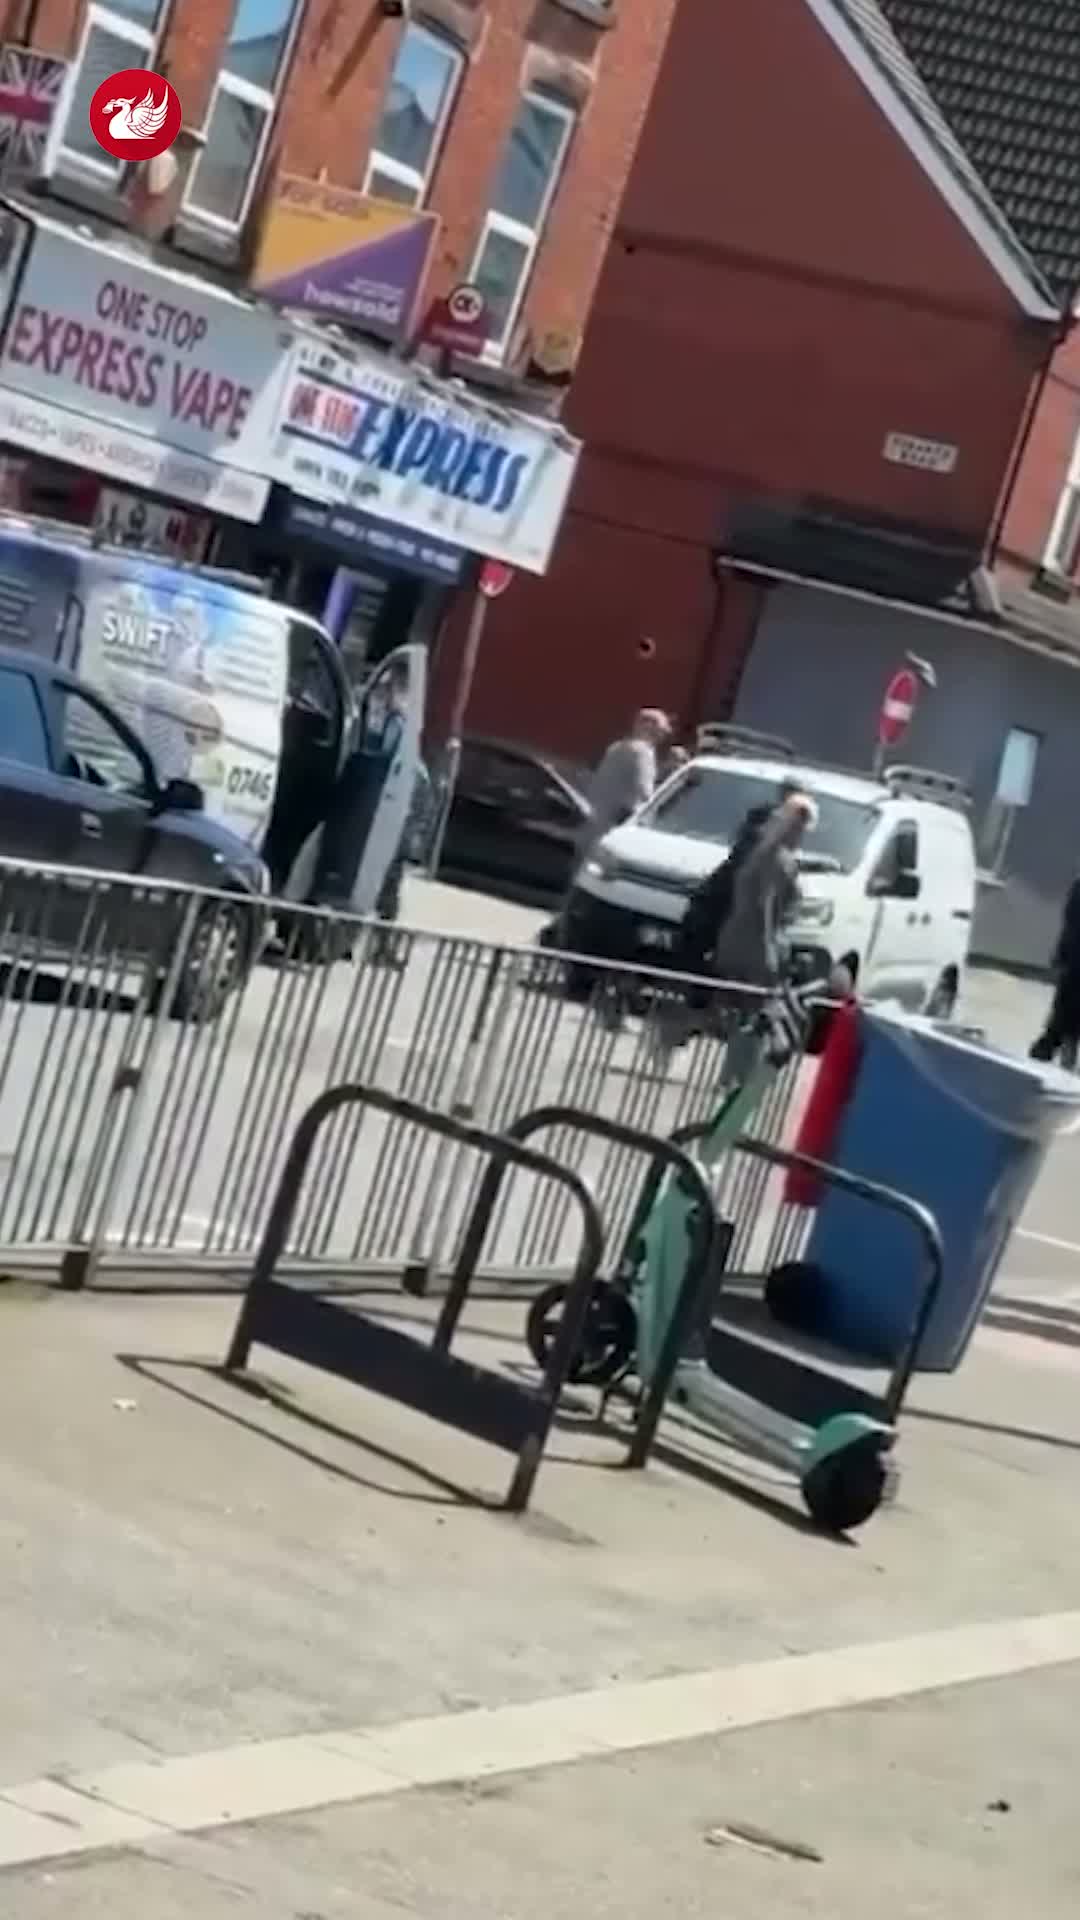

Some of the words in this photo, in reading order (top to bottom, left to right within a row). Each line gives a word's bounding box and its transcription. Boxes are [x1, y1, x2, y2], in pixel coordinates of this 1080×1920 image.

[95, 280, 148, 332] ONE
[146, 301, 209, 352] STOP
[8, 304, 163, 408] EXPRESS
[170, 361, 253, 440] VAPE
[350, 396, 529, 514] EXPRESS
[102, 610, 172, 650] SWIFT
